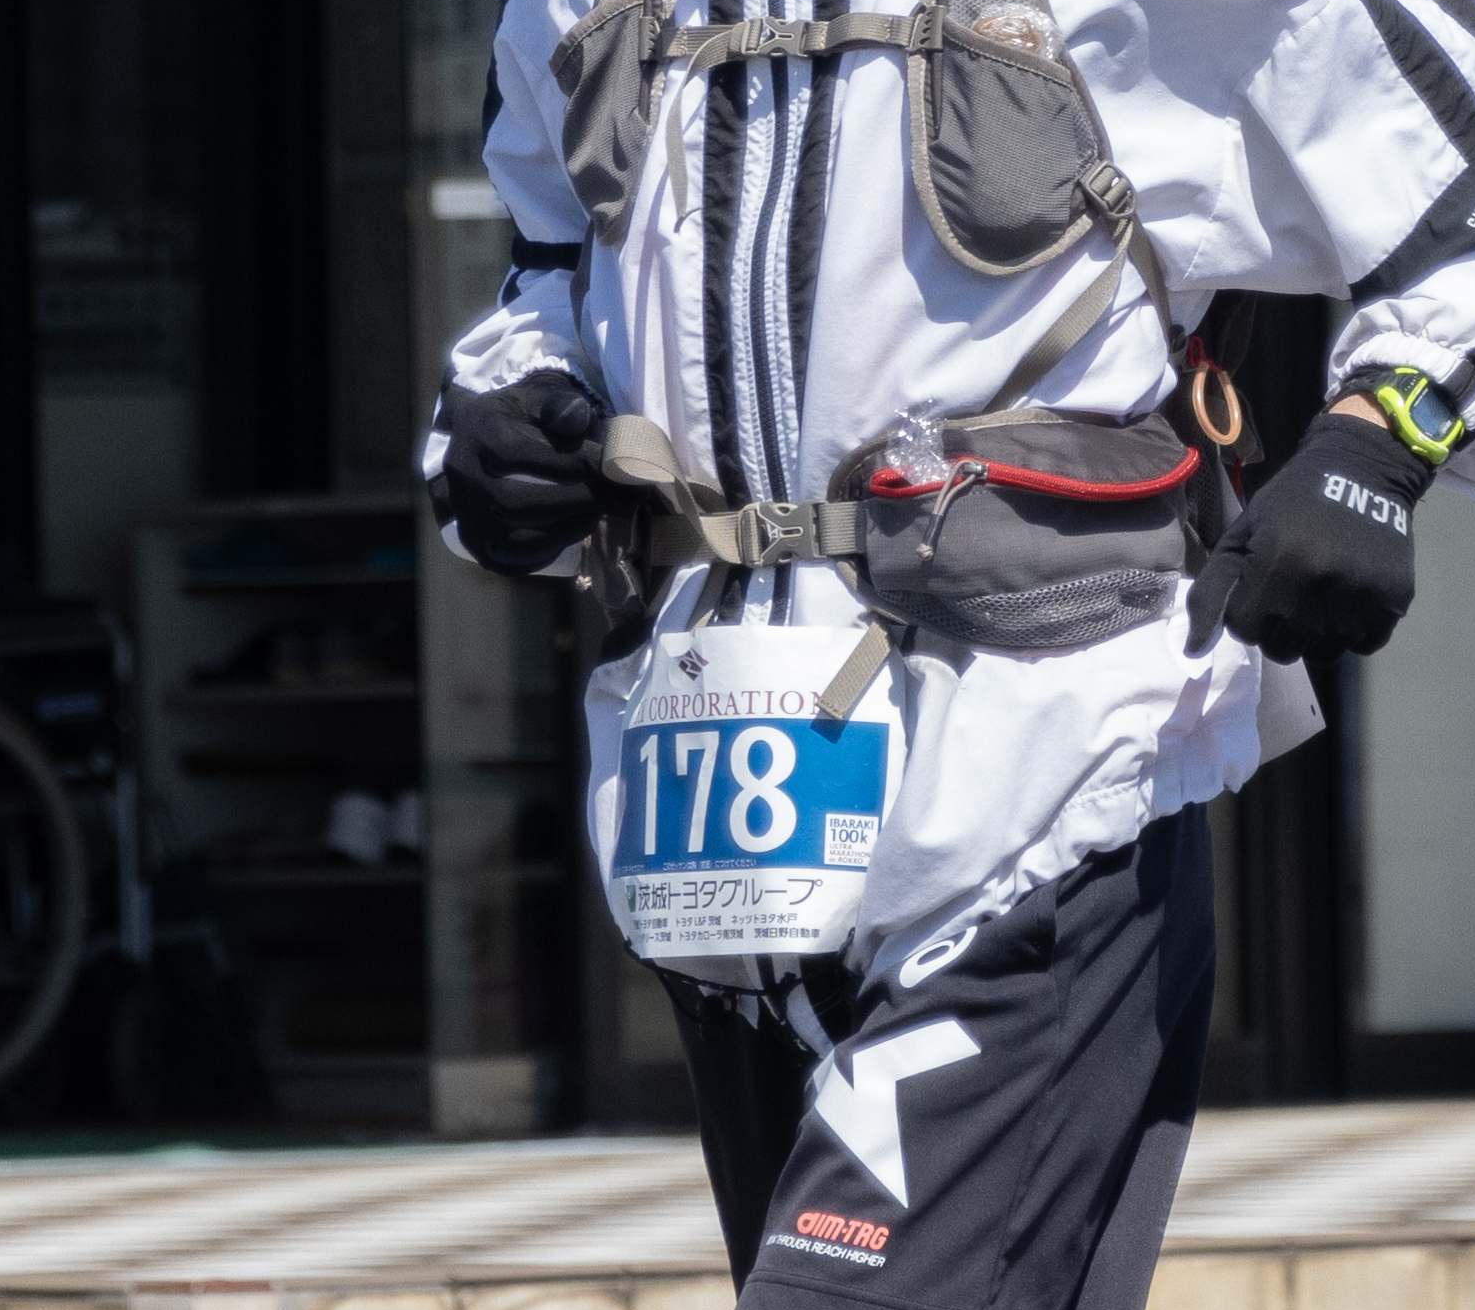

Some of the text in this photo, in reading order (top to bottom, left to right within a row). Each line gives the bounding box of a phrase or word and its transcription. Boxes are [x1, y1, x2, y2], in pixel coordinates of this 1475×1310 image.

[639, 725, 798, 856] 178
[829, 818, 875, 831] IBARAKI
[830, 828, 869, 845] 100k
[638, 878, 824, 912] 茨城トヨタグループ
[811, 1241, 848, 1259] REACH
[845, 1249, 886, 1268] HIGHER
